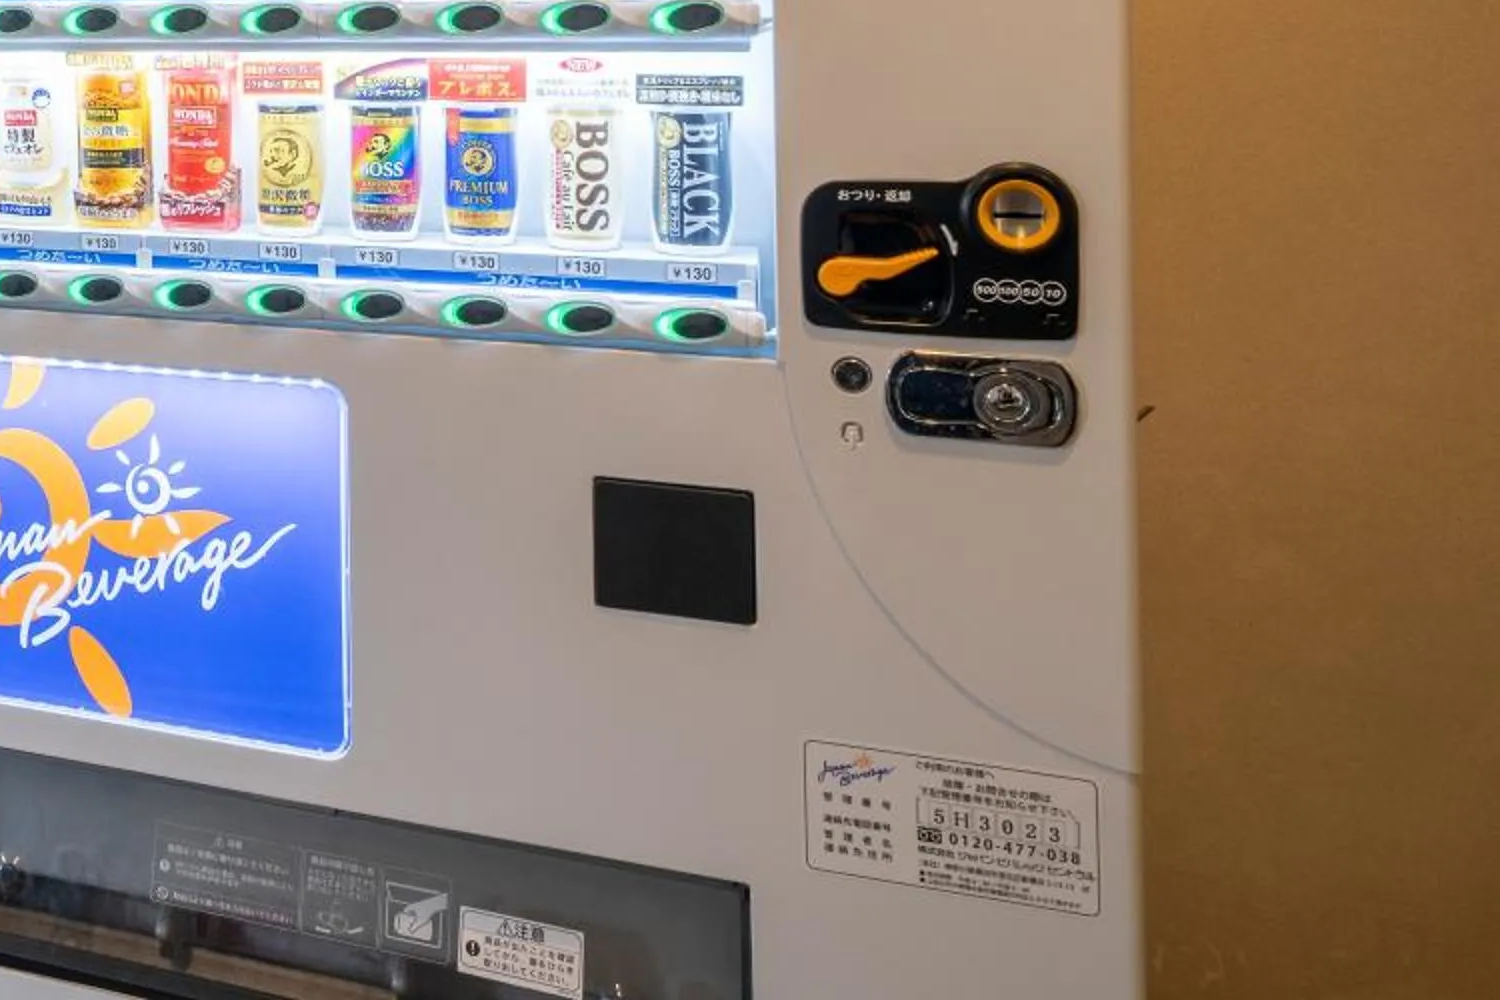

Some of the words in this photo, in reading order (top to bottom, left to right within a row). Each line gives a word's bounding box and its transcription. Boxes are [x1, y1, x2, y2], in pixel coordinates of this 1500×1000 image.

[7, 128, 35, 143] 特製
[575, 121, 610, 232] BOSS
[684, 121, 720, 239] BLACK
[1, 231, 31, 244] ¥130
[86, 236, 117, 249] ¥130
[173, 242, 206, 255] ¥130
[265, 245, 298, 259] ¥130
[360, 251, 394, 264] ¥130
[460, 256, 496, 270] ¥130
[564, 260, 601, 275] ¥130
[674, 266, 713, 281] ¥130
[0, 523, 297, 648] Beverage
[948, 832, 1081, 866] 0120-477-038
